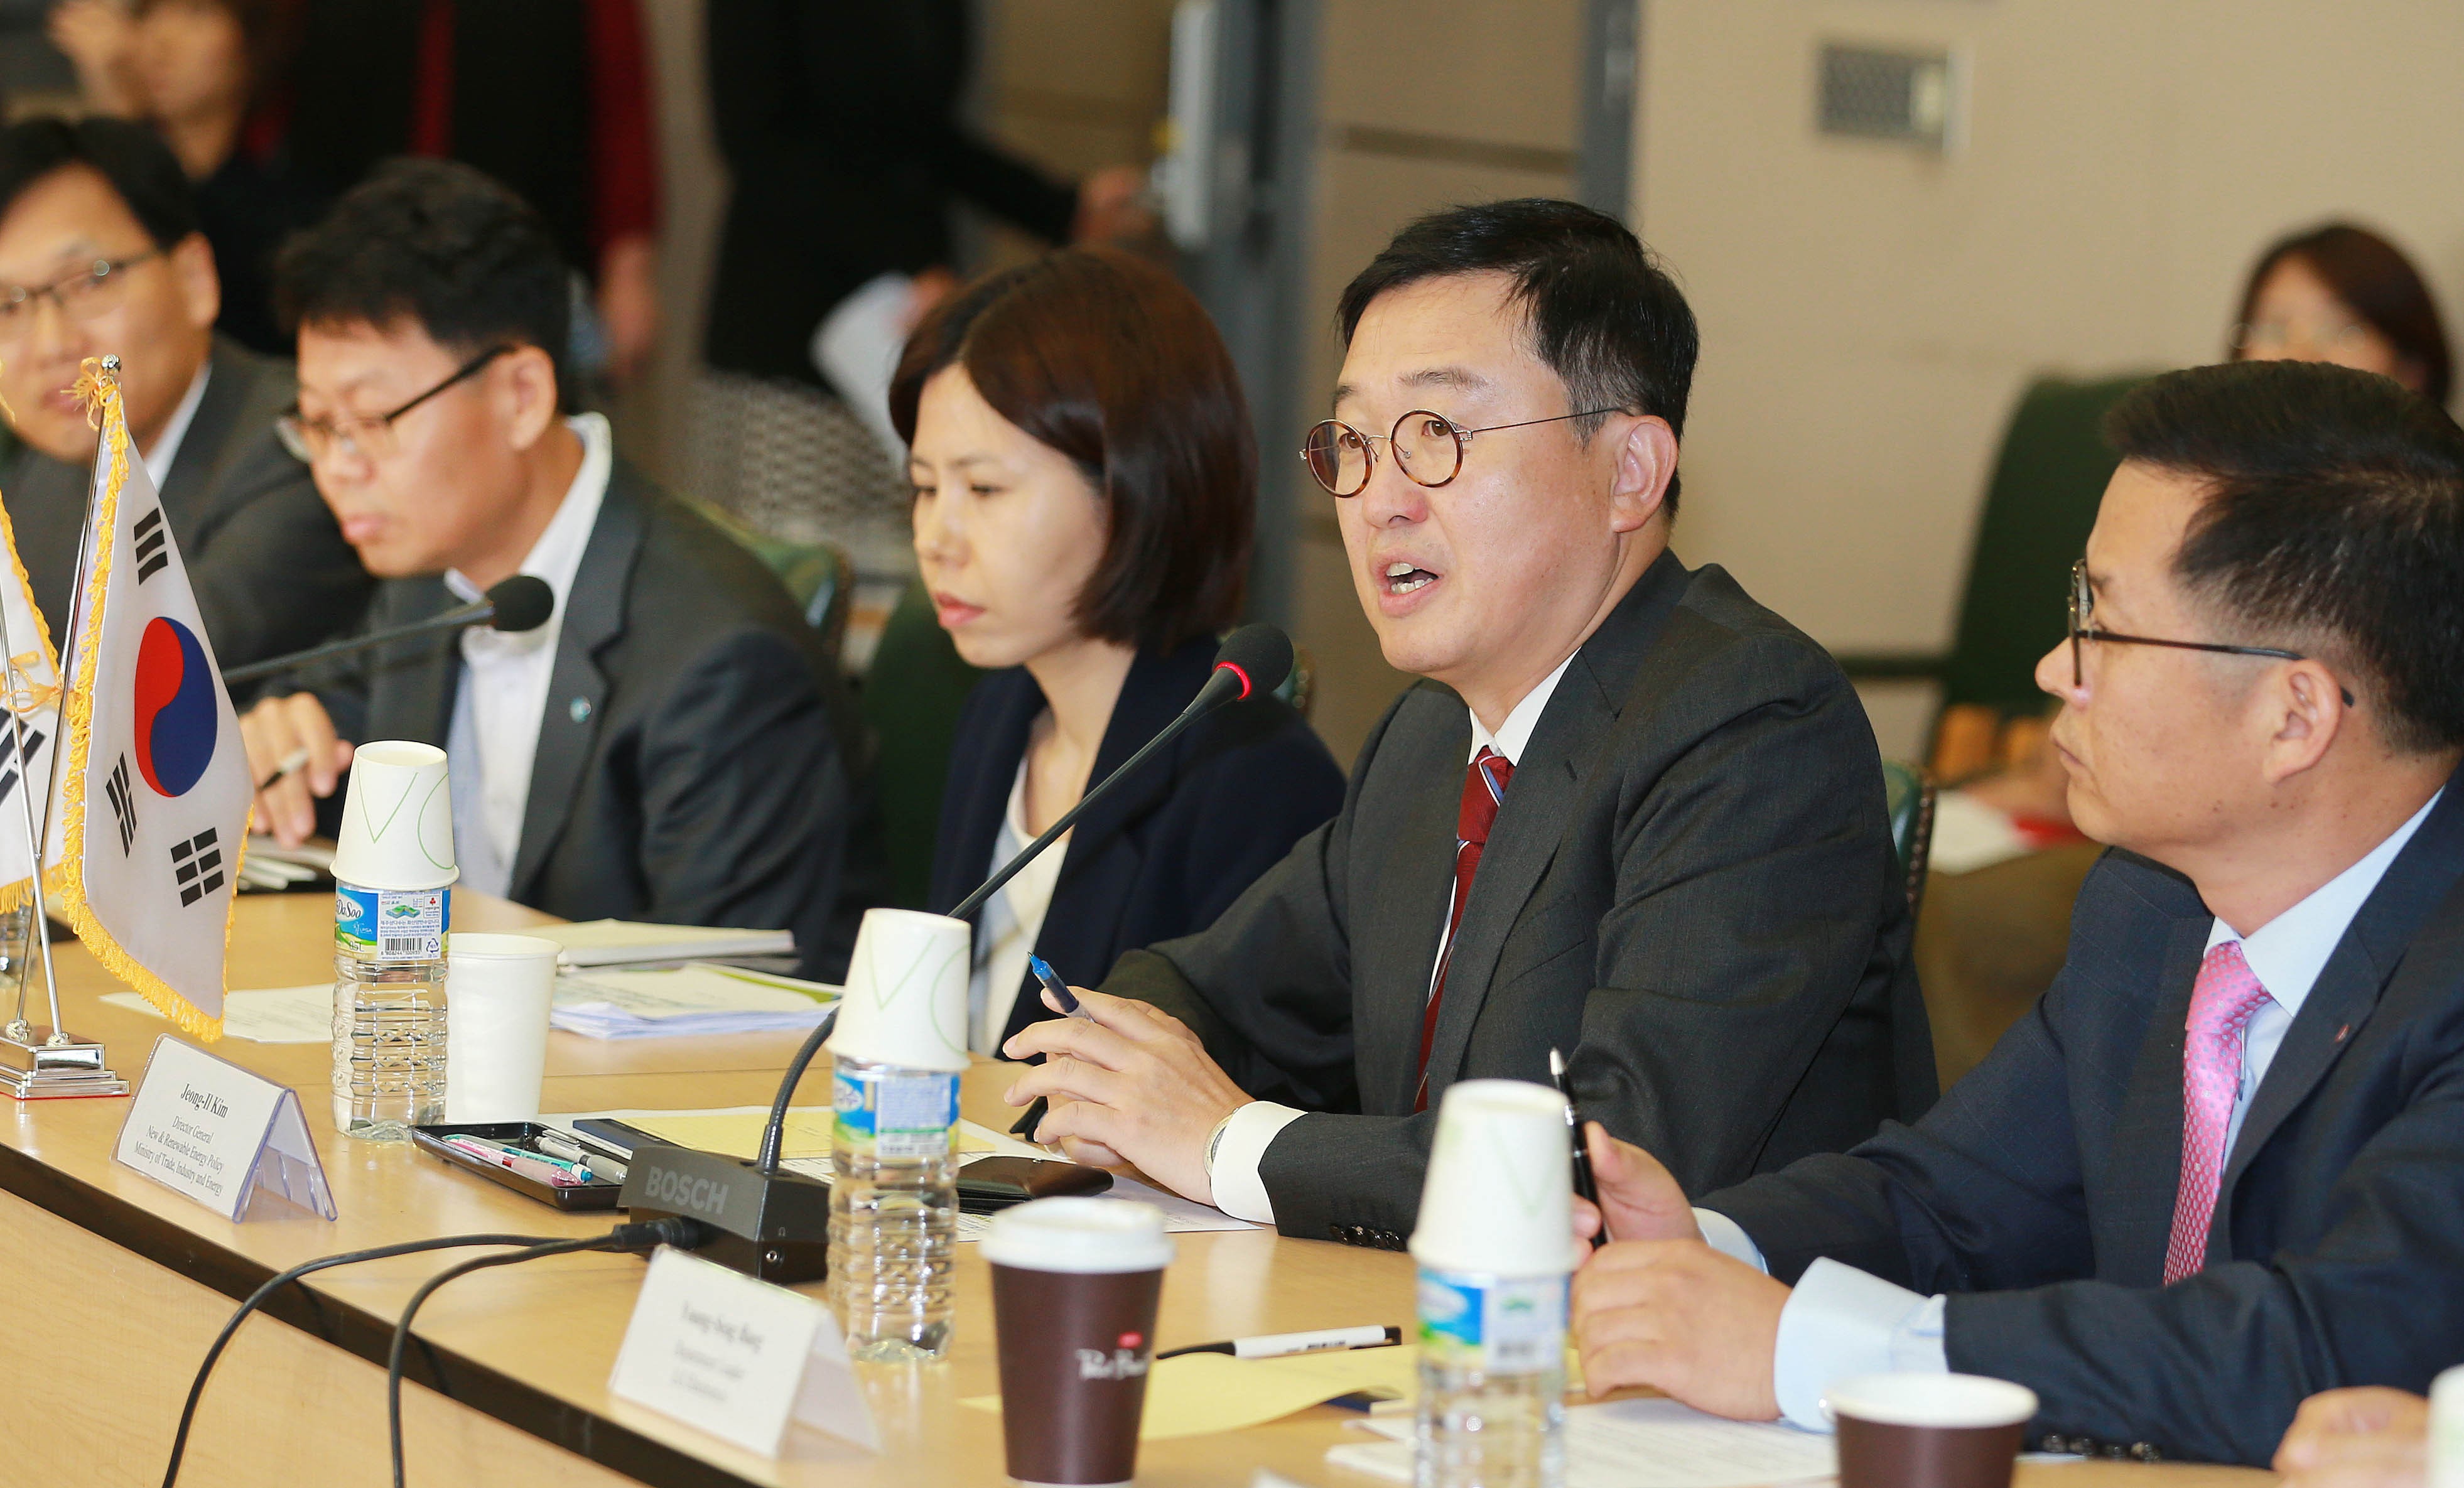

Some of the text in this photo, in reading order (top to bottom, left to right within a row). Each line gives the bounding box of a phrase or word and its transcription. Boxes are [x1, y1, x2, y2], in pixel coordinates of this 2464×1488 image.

[337, 899, 361, 919] DaSoo
[210, 1096, 228, 1118] Kim
[146, 1124, 224, 1175] New & Renewable Energy Policy
[172, 1116, 214, 1144] Director General
[134, 1140, 155, 1164] Ministry
[154, 1151, 162, 1164] of
[175, 1161, 196, 1184] Industry
[195, 1173, 207, 1186] and
[205, 1175, 222, 1197] Energy
[645, 1166, 729, 1216] BOSCH
